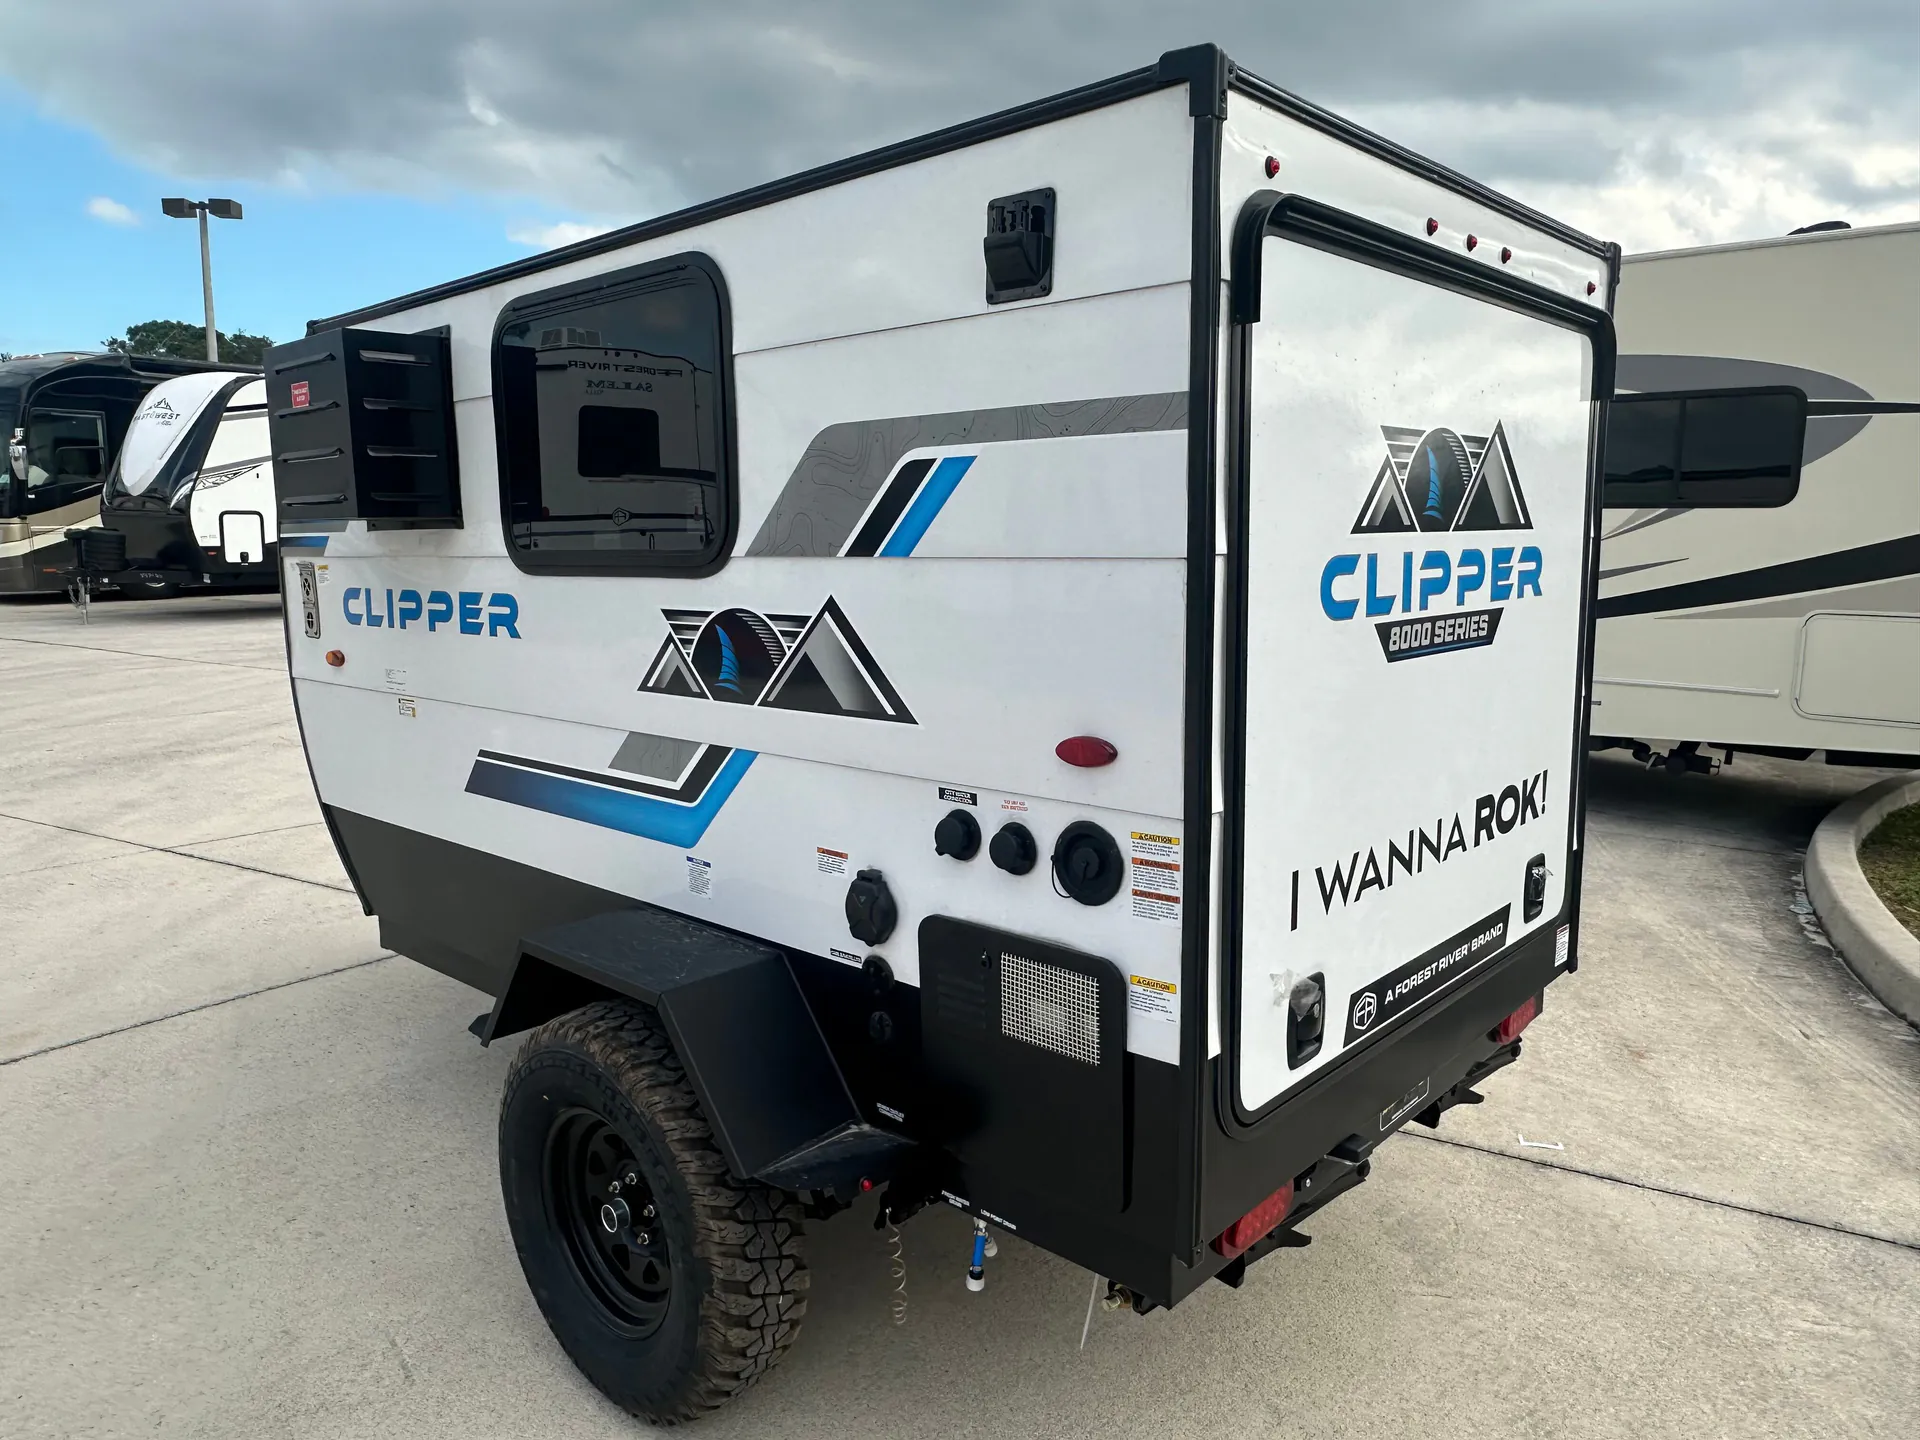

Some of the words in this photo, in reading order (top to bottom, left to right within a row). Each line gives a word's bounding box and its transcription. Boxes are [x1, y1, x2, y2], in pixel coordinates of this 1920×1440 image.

[1319, 545, 1543, 622] CLIPPER
[342, 587, 522, 640] CLIPPER
[1389, 622, 1431, 652] 8000
[1434, 614, 1489, 644] SERIES
[1142, 833, 1172, 845] CAUTION
[1290, 869, 1299, 932] I
[1314, 812, 1468, 916] WANNA
[1473, 768, 1549, 849] ROK!
[1142, 979, 1170, 991] CAUTION
[1384, 989, 1394, 1005] A
[1395, 961, 1438, 998] FOREST
[1471, 922, 1504, 952] BRAND
